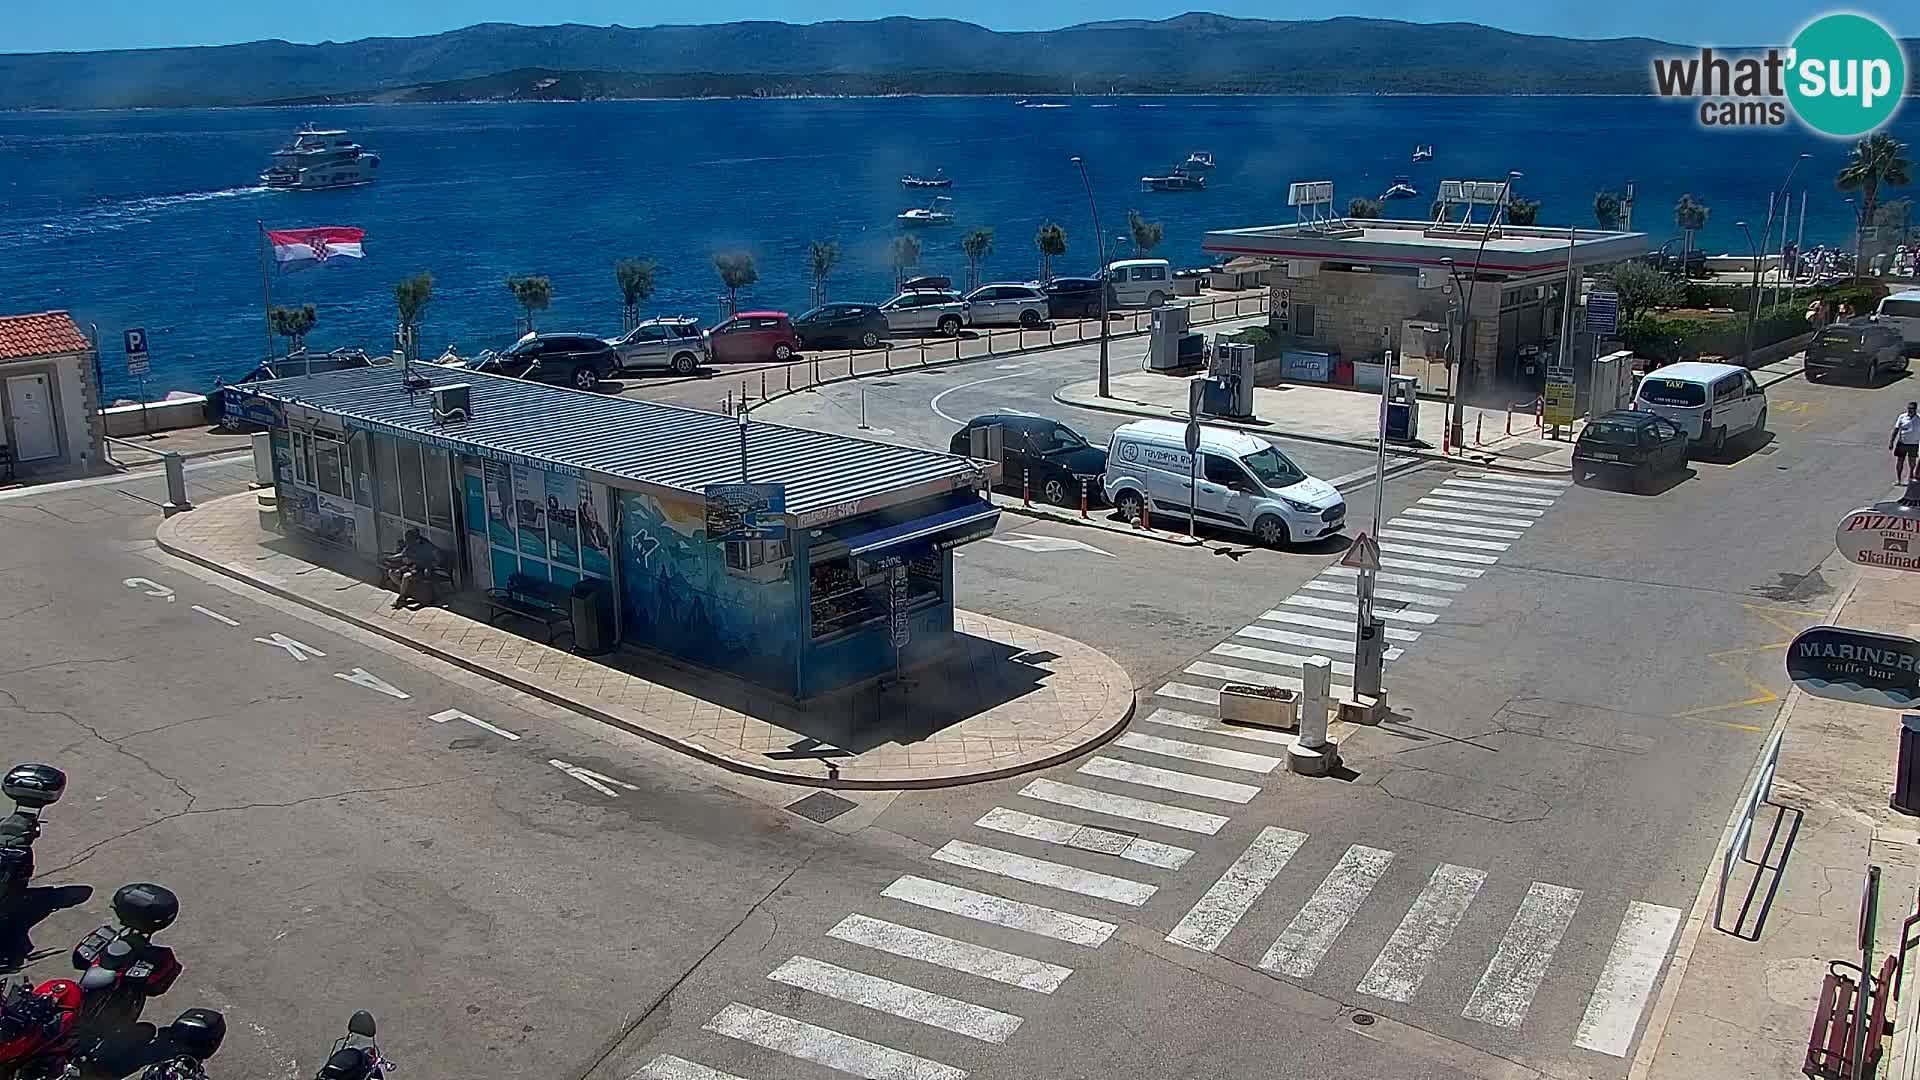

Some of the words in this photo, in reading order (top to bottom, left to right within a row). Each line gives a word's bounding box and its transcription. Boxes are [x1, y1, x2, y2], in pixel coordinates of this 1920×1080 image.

[129, 332, 141, 350] P
[1665, 380, 1684, 389] TAXI
[476, 446, 491, 458] BUS
[493, 450, 525, 465] STATION
[527, 457, 553, 471] TICKET
[554, 463, 581, 477] OFFICE
[1880, 530, 1914, 541] GRILL
[1827, 662, 1864, 673] caffe
[1869, 665, 1895, 680] bar
